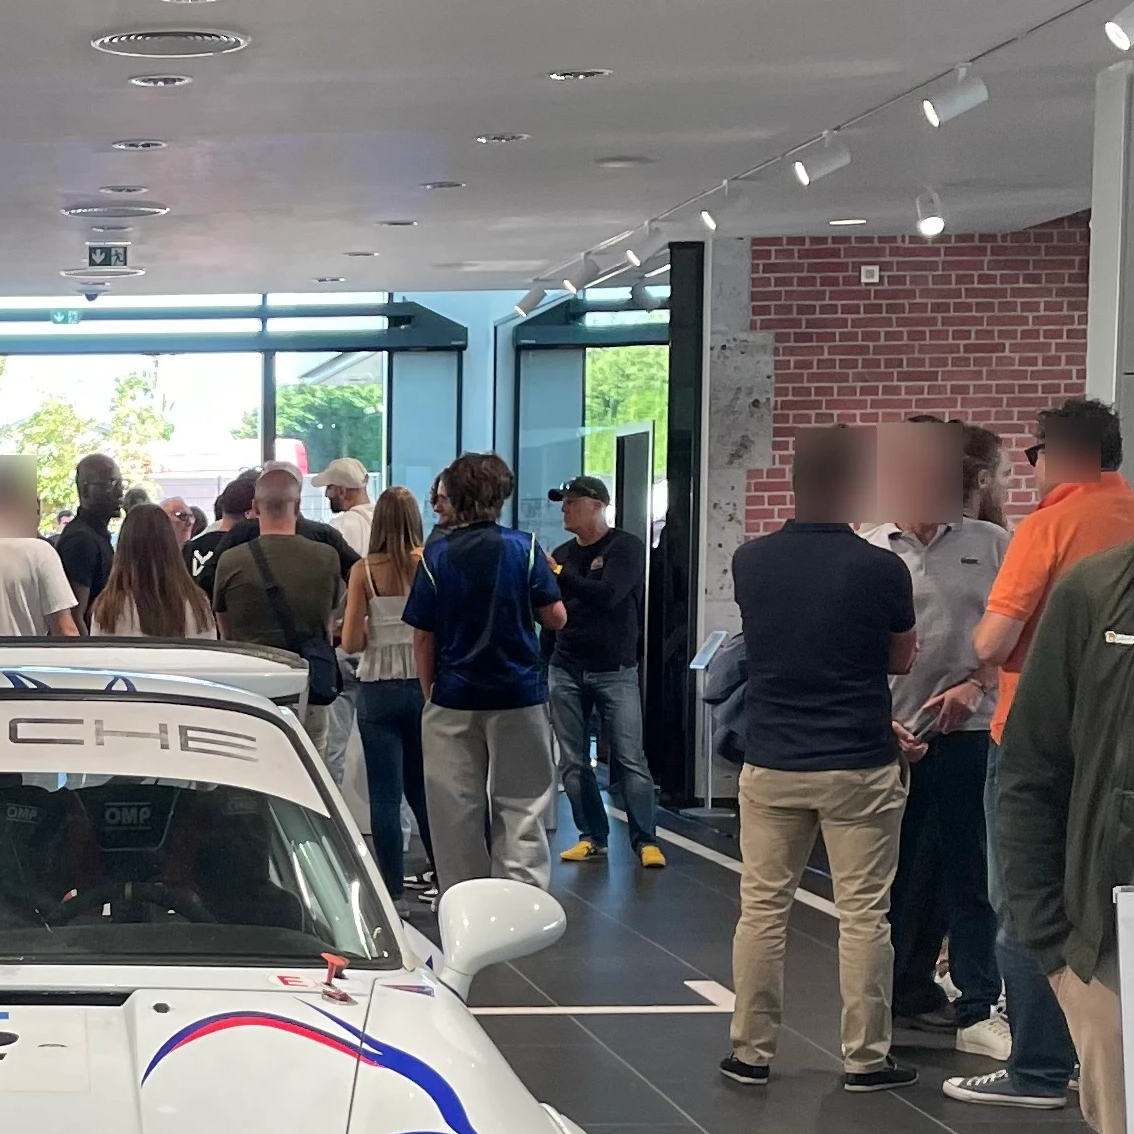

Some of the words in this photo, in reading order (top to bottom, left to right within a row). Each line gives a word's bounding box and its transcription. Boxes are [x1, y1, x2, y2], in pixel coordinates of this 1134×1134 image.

[7, 806, 38, 820] OMP
[104, 808, 152, 825] OMP
[277, 976, 308, 987] E
